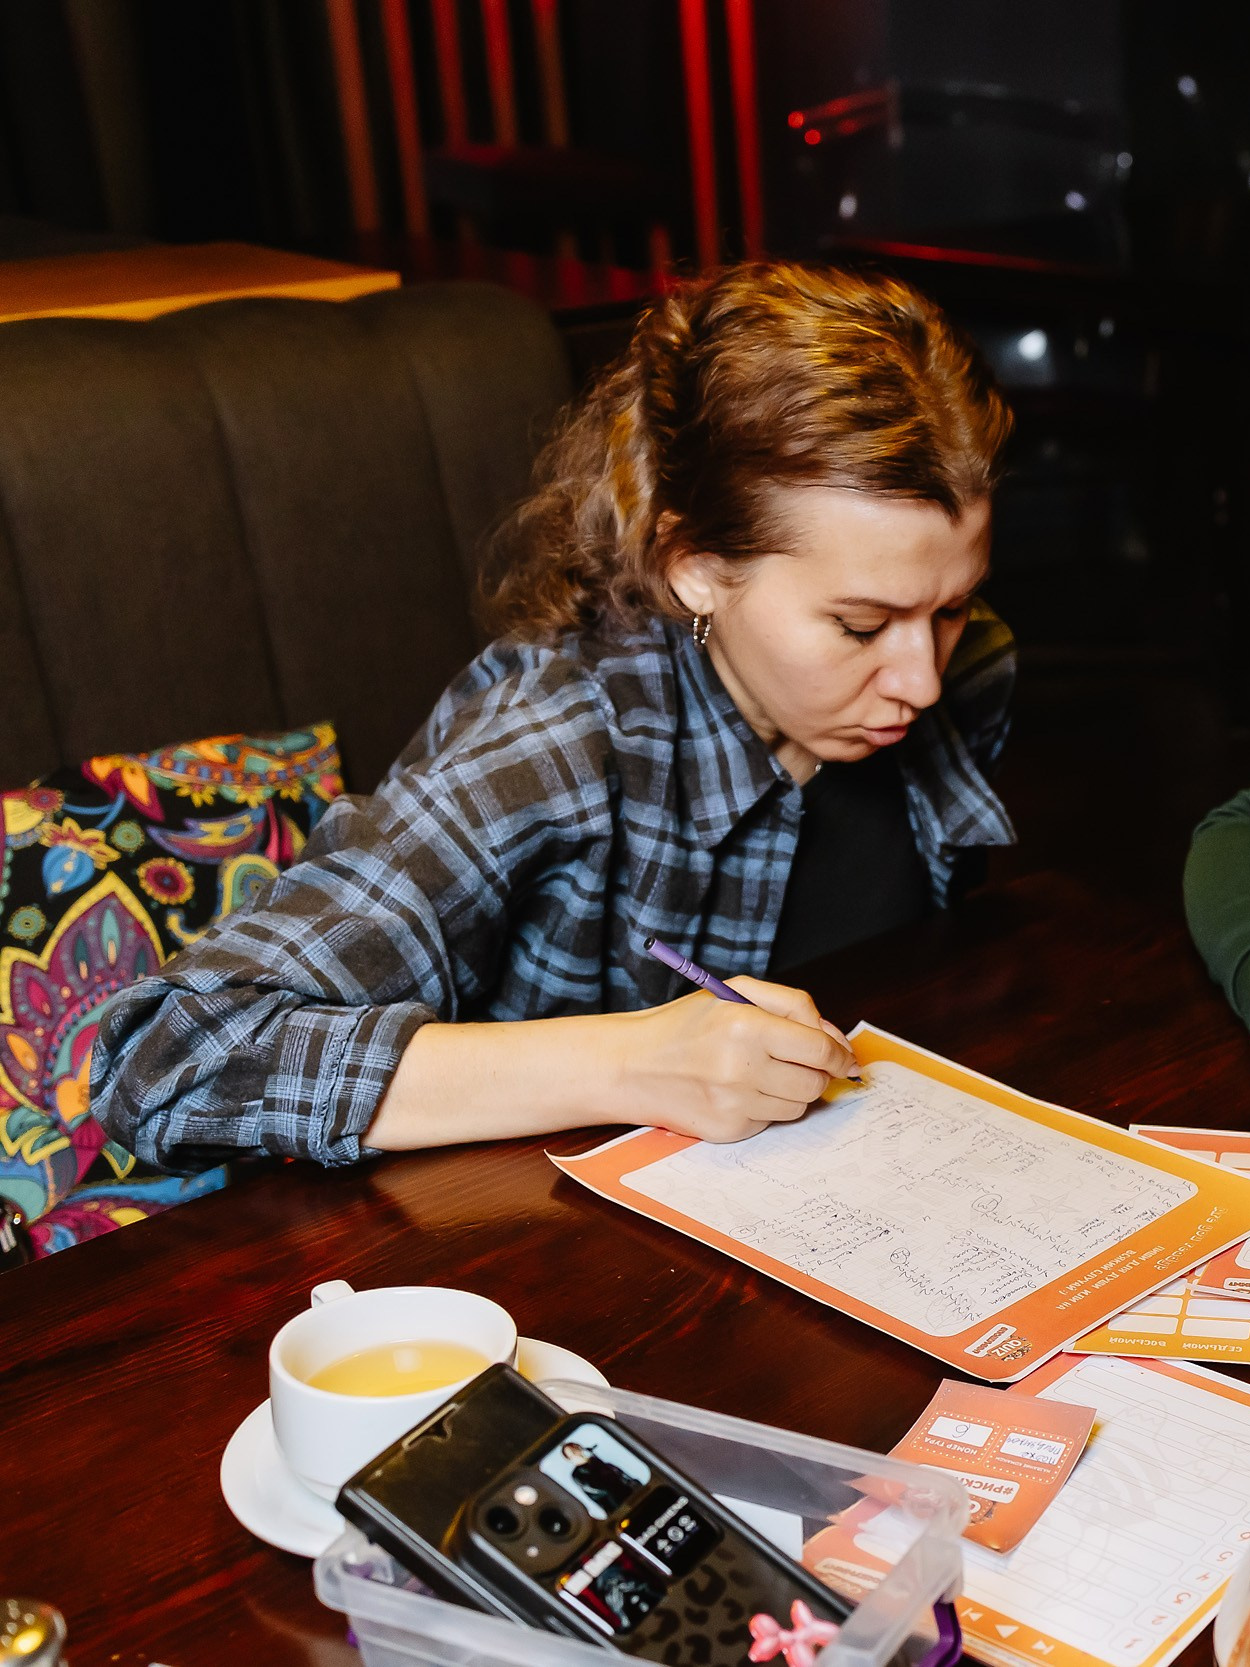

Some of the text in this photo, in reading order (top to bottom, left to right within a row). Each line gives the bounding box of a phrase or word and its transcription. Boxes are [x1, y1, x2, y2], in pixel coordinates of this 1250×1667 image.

[1190, 1224, 1213, 1242] you
[1101, 1249, 1137, 1271] ВСЯКИЙ
[1056, 1245, 1165, 1310] ПИШИ ДЛЯ ДУШИ ИЛИ НА
[1066, 1269, 1103, 1291] СЛУЧАЙ
[991, 1339, 1022, 1357] QUIZ
[1108, 1337, 1167, 1347] ВОСЬМОЙ
[1182, 1342, 1243, 1353] СЕДЬМОЙ
[952, 1424, 970, 1439] 6
[924, 1436, 977, 1455] НОМЕР ТУРА
[1217, 1551, 1234, 1562] 5
[1196, 1572, 1211, 1582] 4
[1173, 1592, 1191, 1606] 3
[1152, 1616, 1169, 1626] 2
[1125, 1638, 1143, 1649] 1
